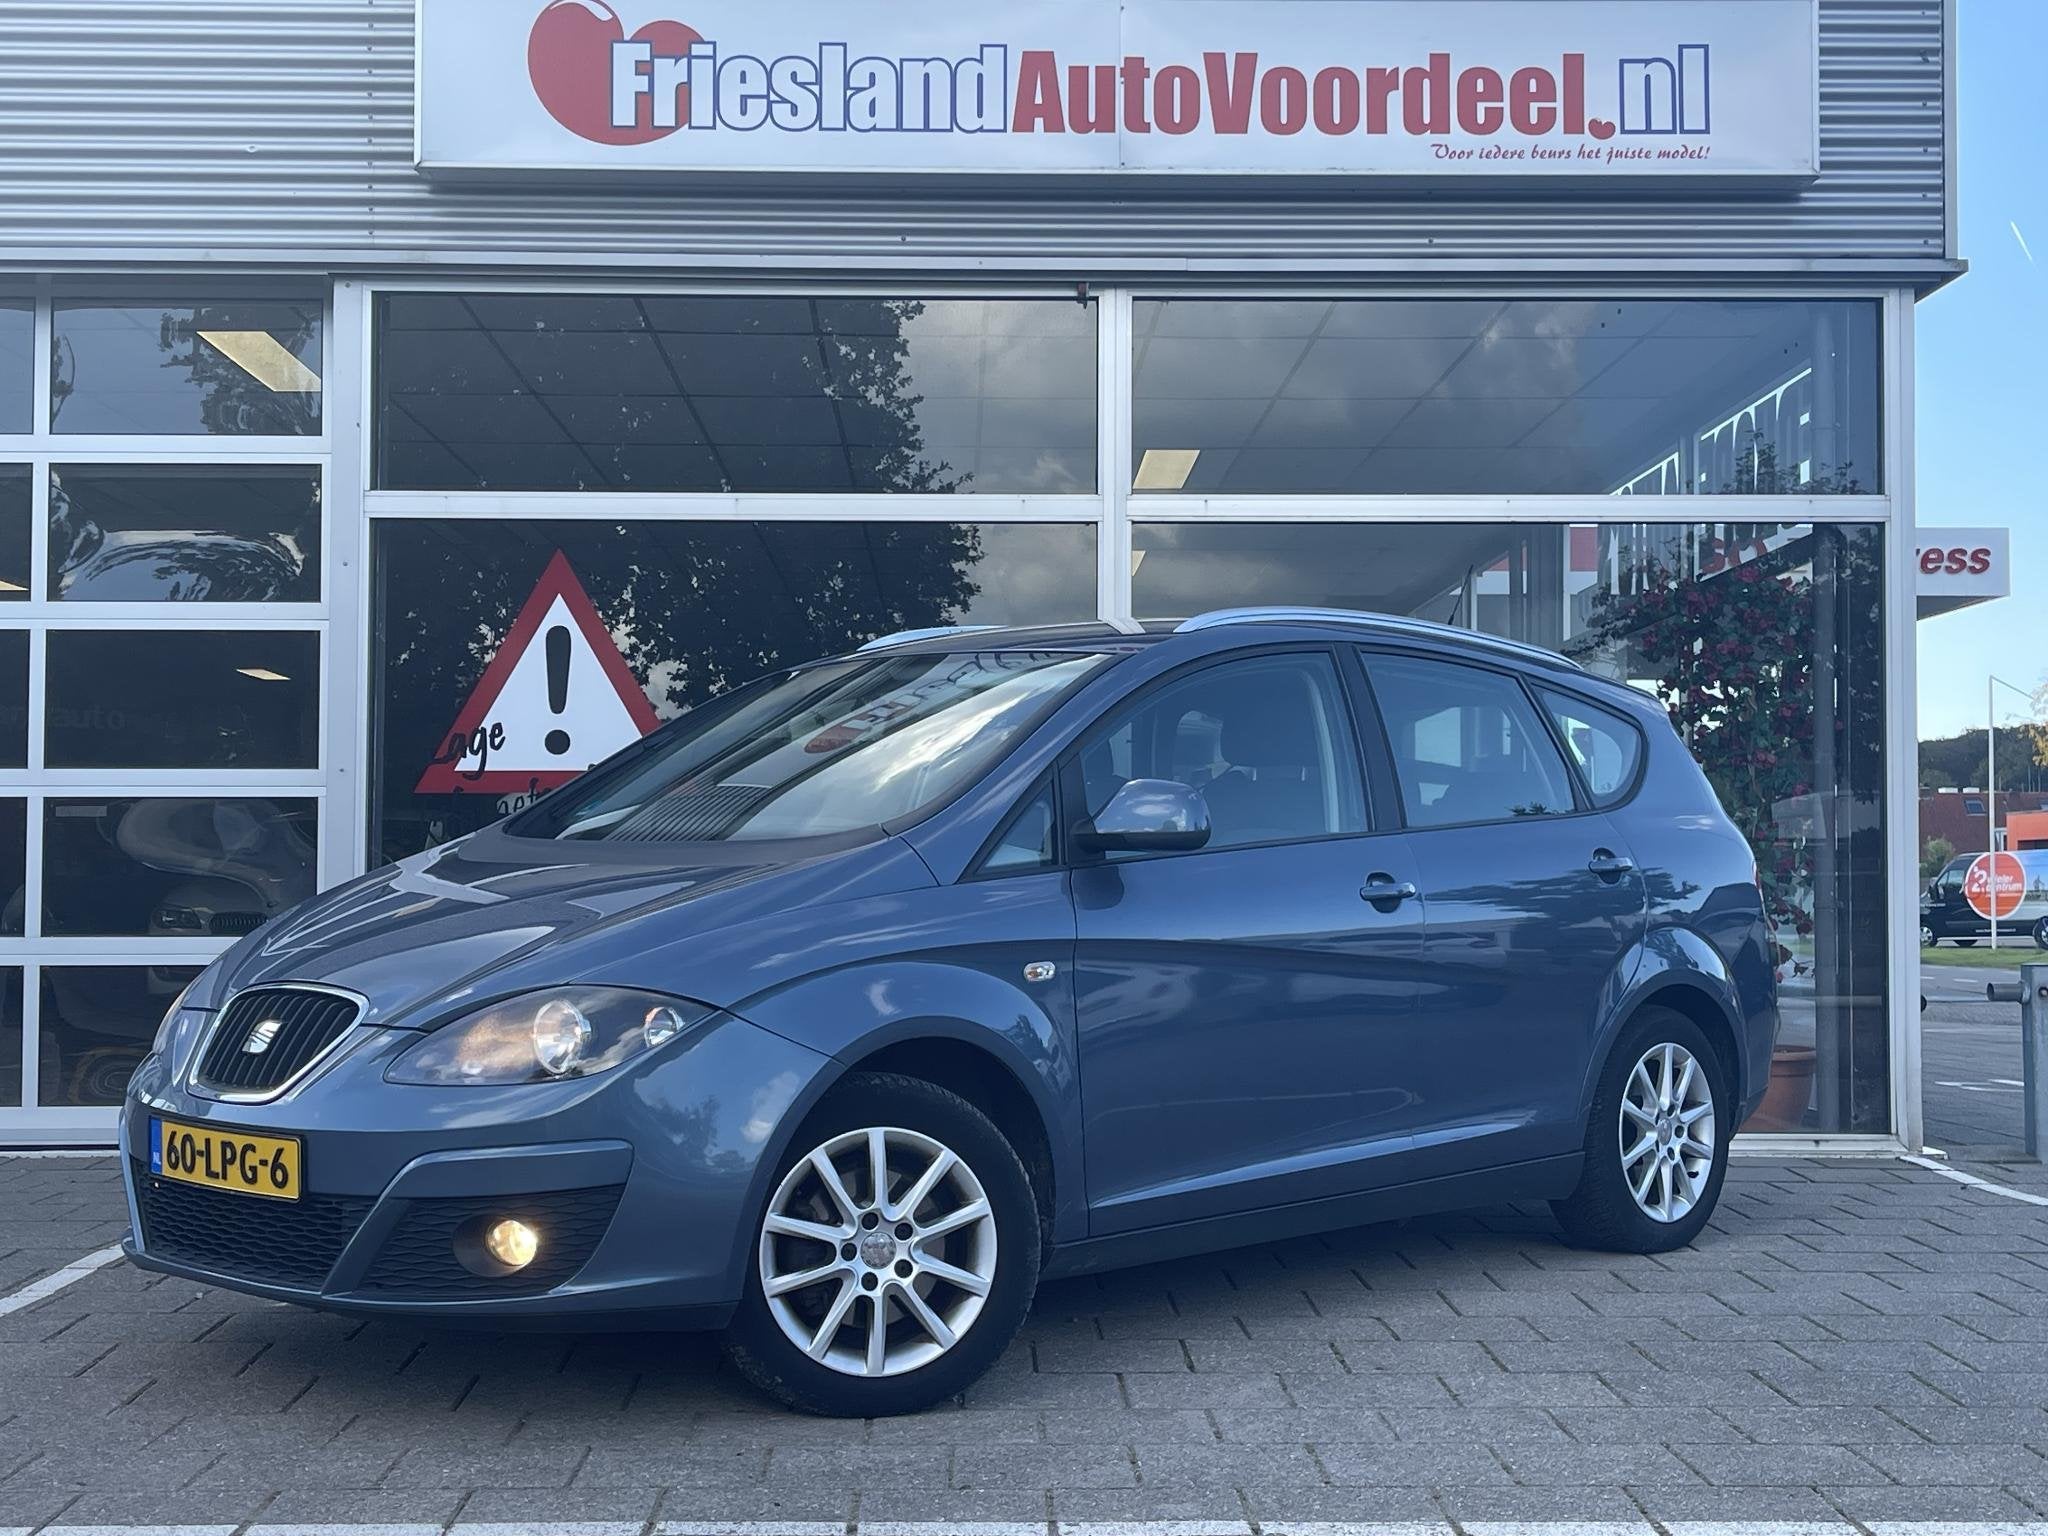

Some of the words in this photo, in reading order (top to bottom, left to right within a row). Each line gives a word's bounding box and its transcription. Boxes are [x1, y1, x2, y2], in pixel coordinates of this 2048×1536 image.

[610, 40, 1711, 138] FrieslandAutoVoordeel.nl
[1430, 143, 1473, 160] Voor
[1478, 144, 1525, 160] iedere
[1531, 144, 1571, 160] beurs
[1577, 144, 1602, 160] het
[1606, 145, 1652, 165] juiste
[1657, 144, 1711, 160] model!
[1915, 547, 1991, 575] ess
[166, 1130, 289, 1190] 60-LPG-6
